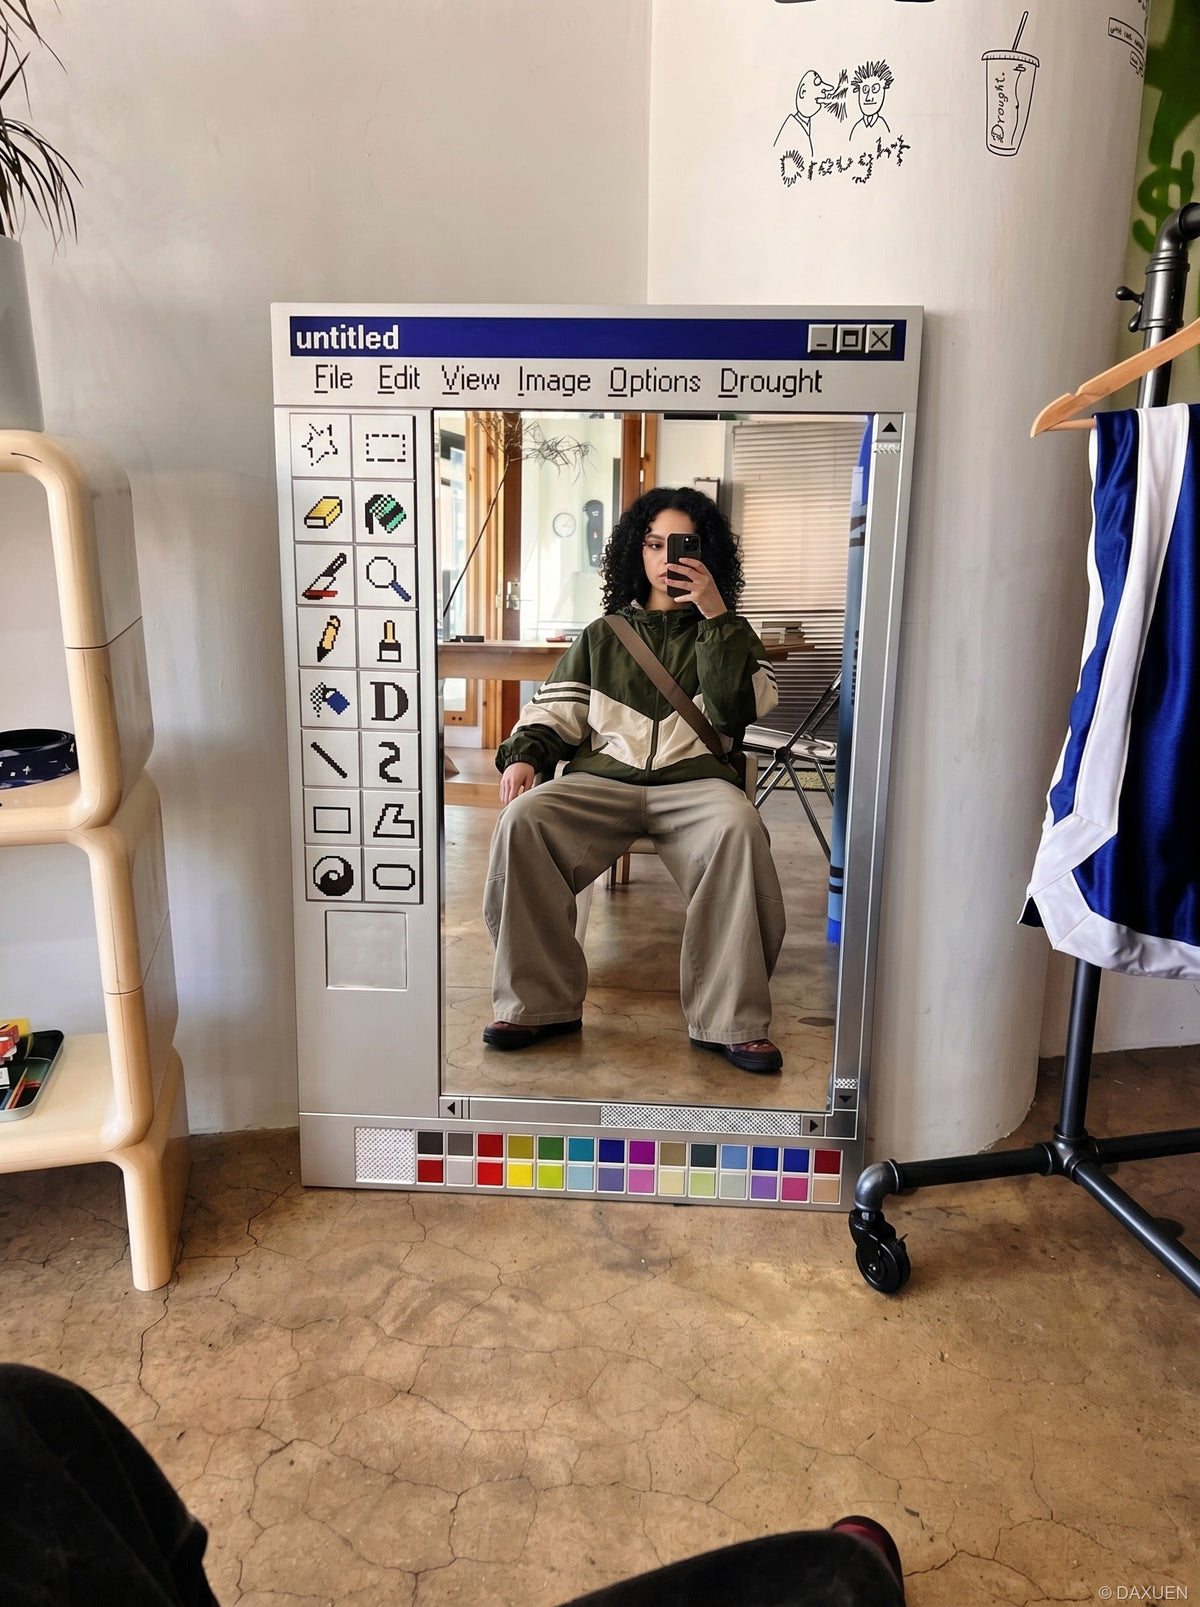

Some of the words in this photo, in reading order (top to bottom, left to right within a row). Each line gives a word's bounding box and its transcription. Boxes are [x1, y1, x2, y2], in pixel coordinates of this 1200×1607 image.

[780, 135, 911, 188] Drought
[296, 324, 399, 350] untitled
[314, 364, 353, 394] File
[377, 365, 421, 395] Edit
[441, 365, 500, 395] View
[518, 366, 591, 397] Image
[608, 367, 701, 398] Options
[718, 367, 823, 398] Drought
[370, 681, 409, 721] D
